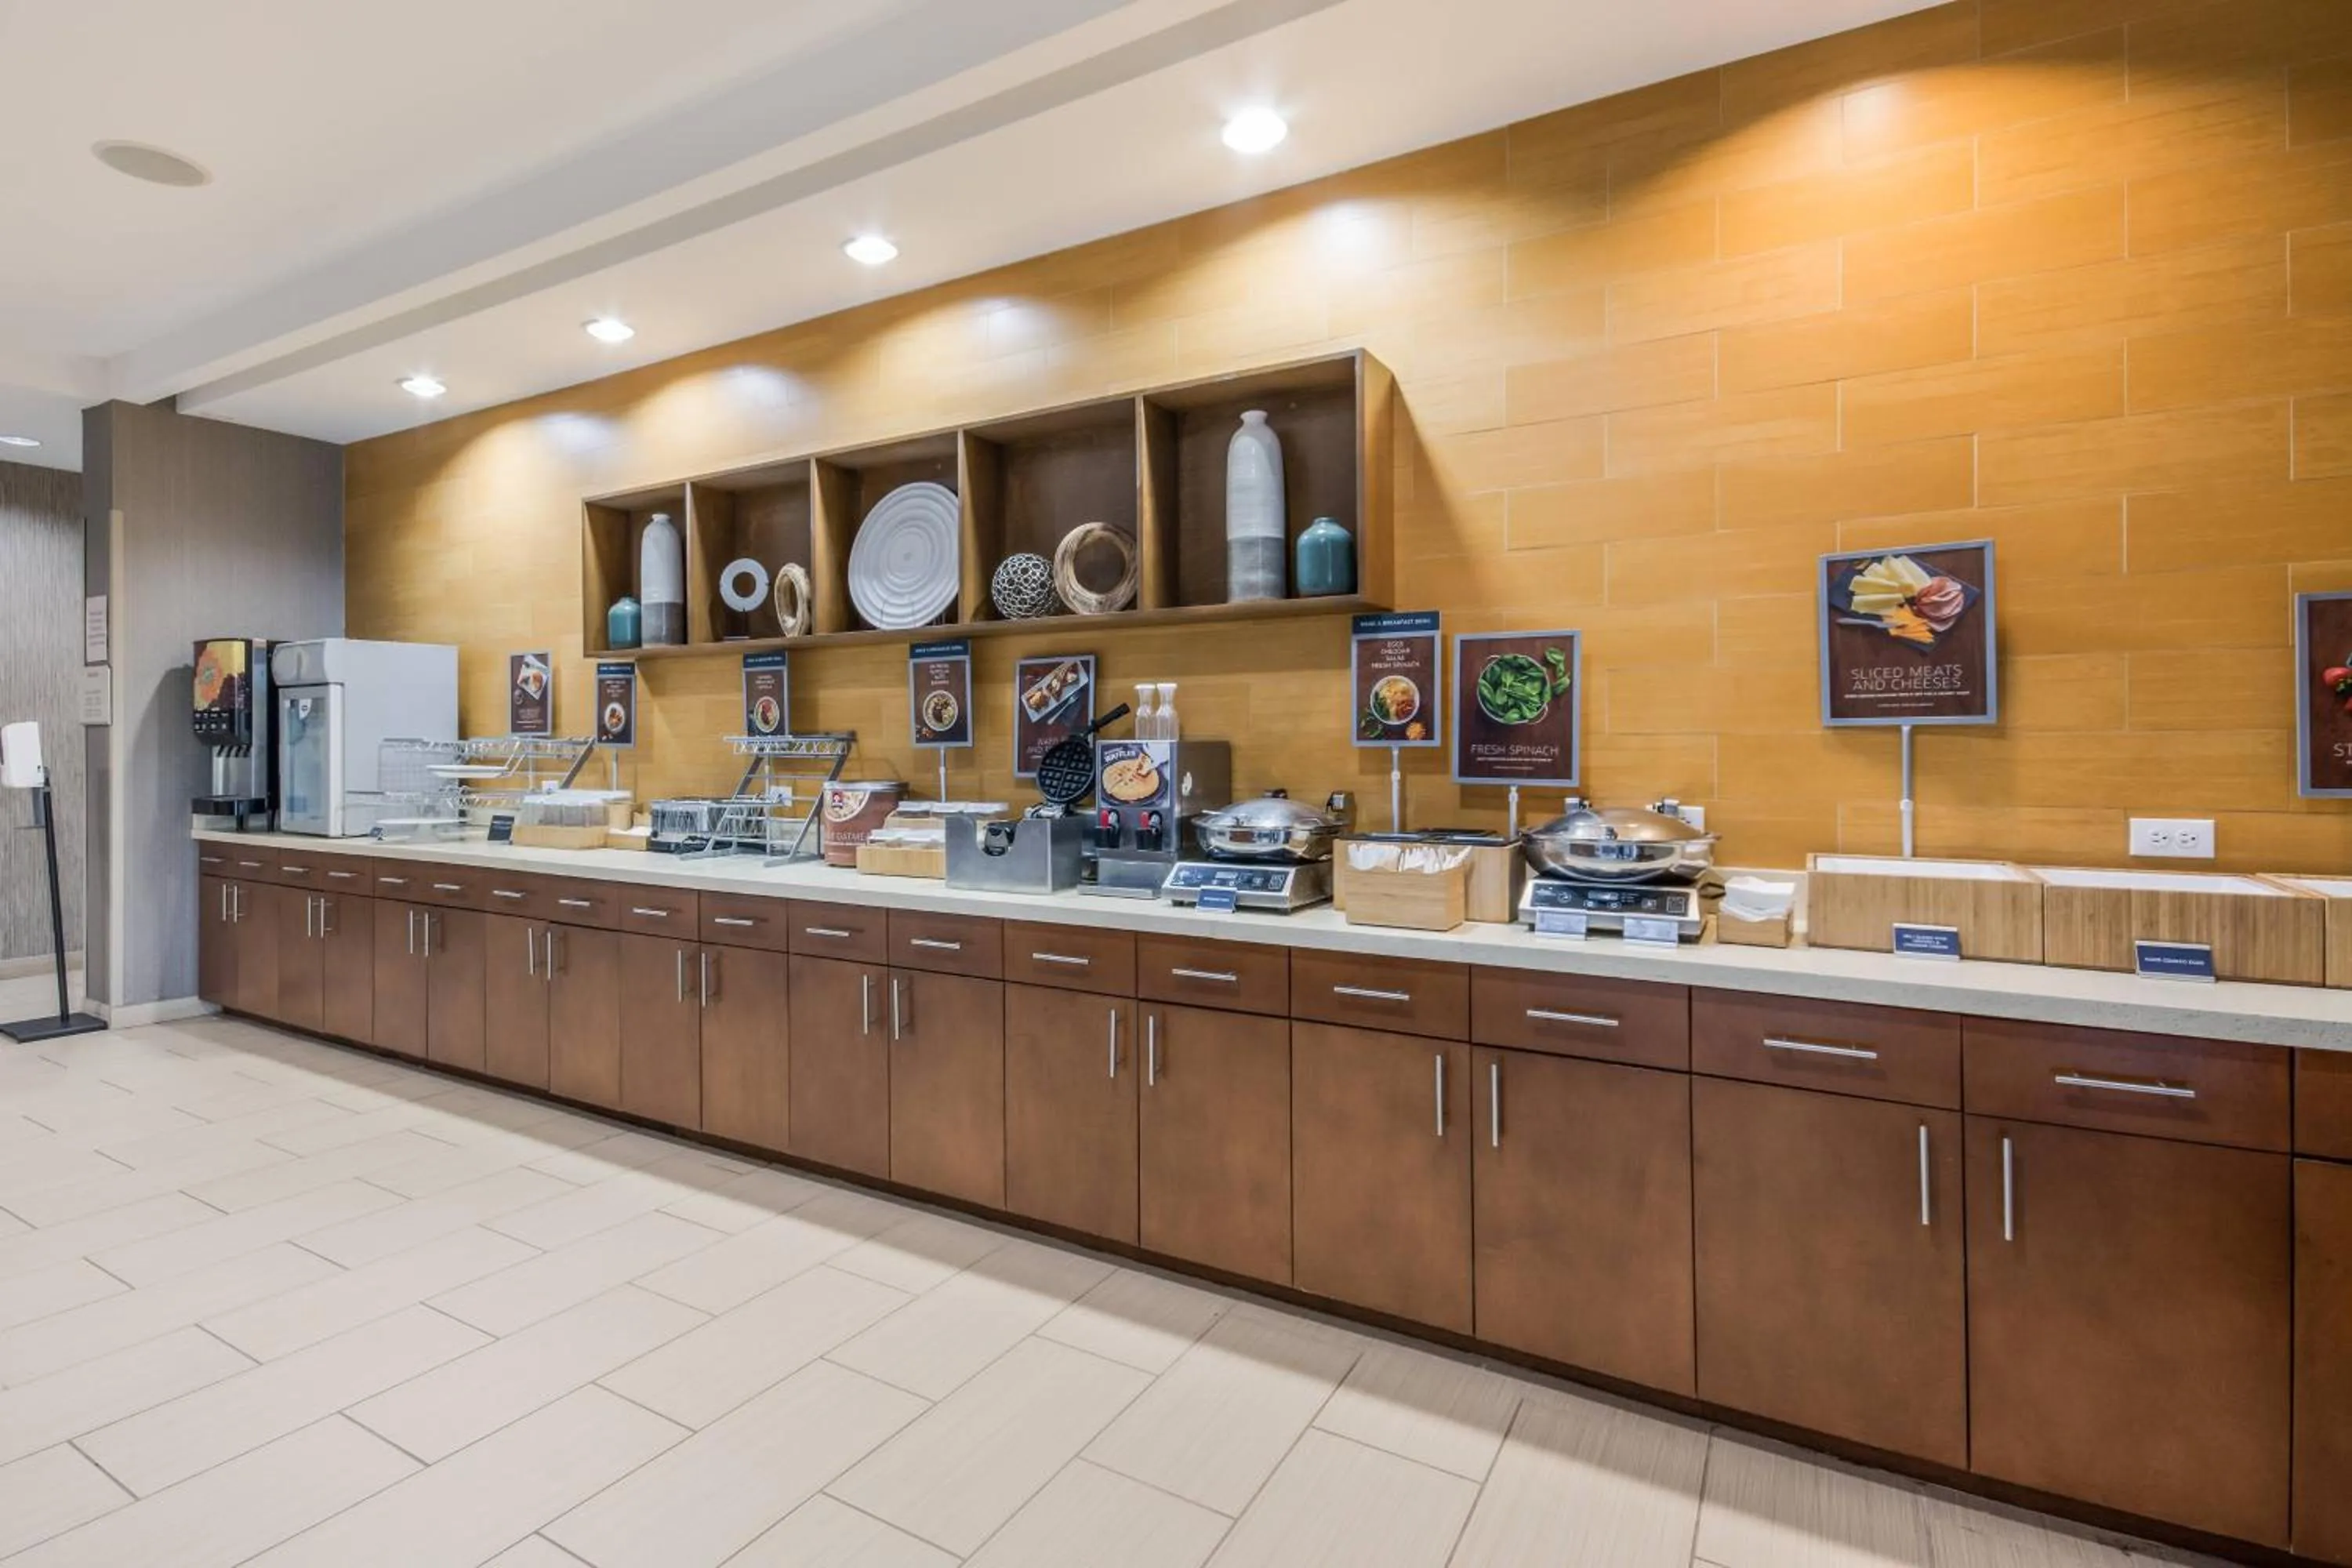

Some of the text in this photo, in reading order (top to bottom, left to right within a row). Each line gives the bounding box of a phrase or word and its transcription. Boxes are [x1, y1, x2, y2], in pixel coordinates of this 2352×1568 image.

[1851, 664, 1962, 680] SLICED MEATS
[1853, 677, 1961, 691] AND CHEESES
[1471, 744, 1559, 756] FRESH SPINACH
